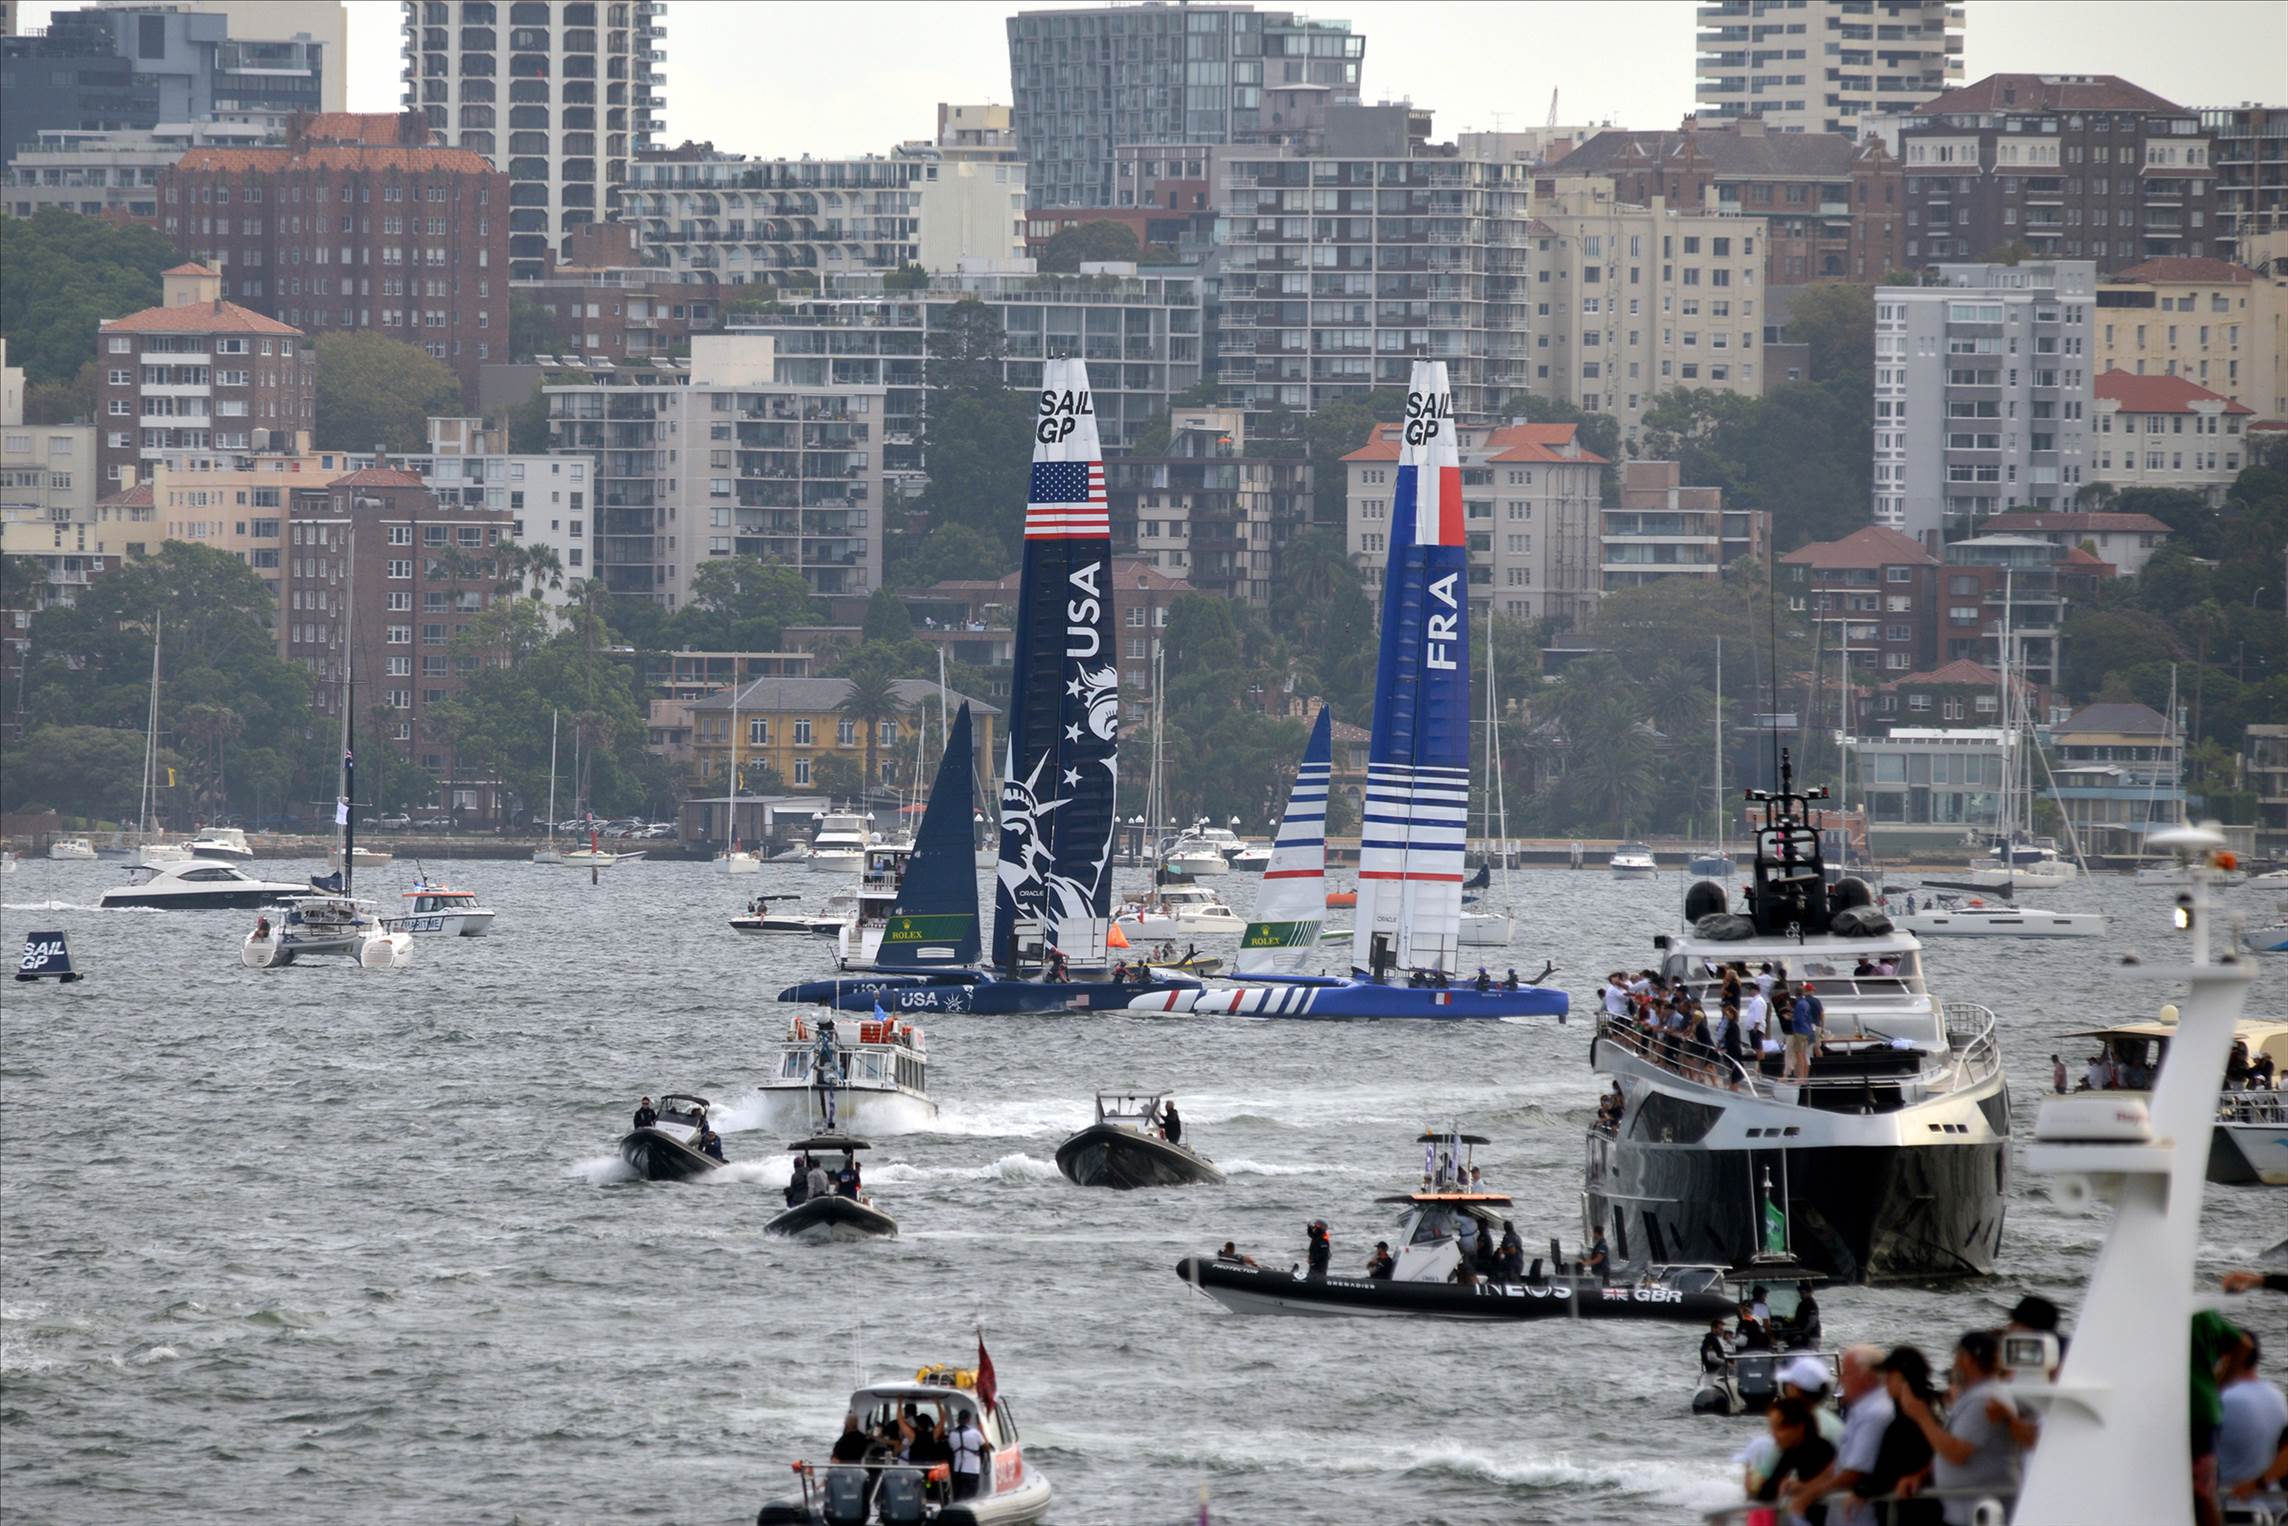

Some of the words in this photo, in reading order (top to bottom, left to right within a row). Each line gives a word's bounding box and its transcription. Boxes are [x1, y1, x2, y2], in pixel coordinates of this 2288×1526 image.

[1039, 389, 1093, 416] SAIL
[1406, 391, 1455, 419] SAIL
[1037, 417, 1076, 444] GP
[1405, 419, 1440, 446] GP
[1066, 561, 1101, 657] USA
[1426, 572, 1458, 670] FRA
[892, 931, 922, 940] ROLEX
[1251, 937, 1281, 946] ROLEX
[23, 941, 65, 956] SAIL
[20, 955, 49, 970] GP
[901, 992, 939, 1007] USA
[1326, 1280, 1376, 1290] GRENADIER
[1633, 1288, 1684, 1304] GBR
